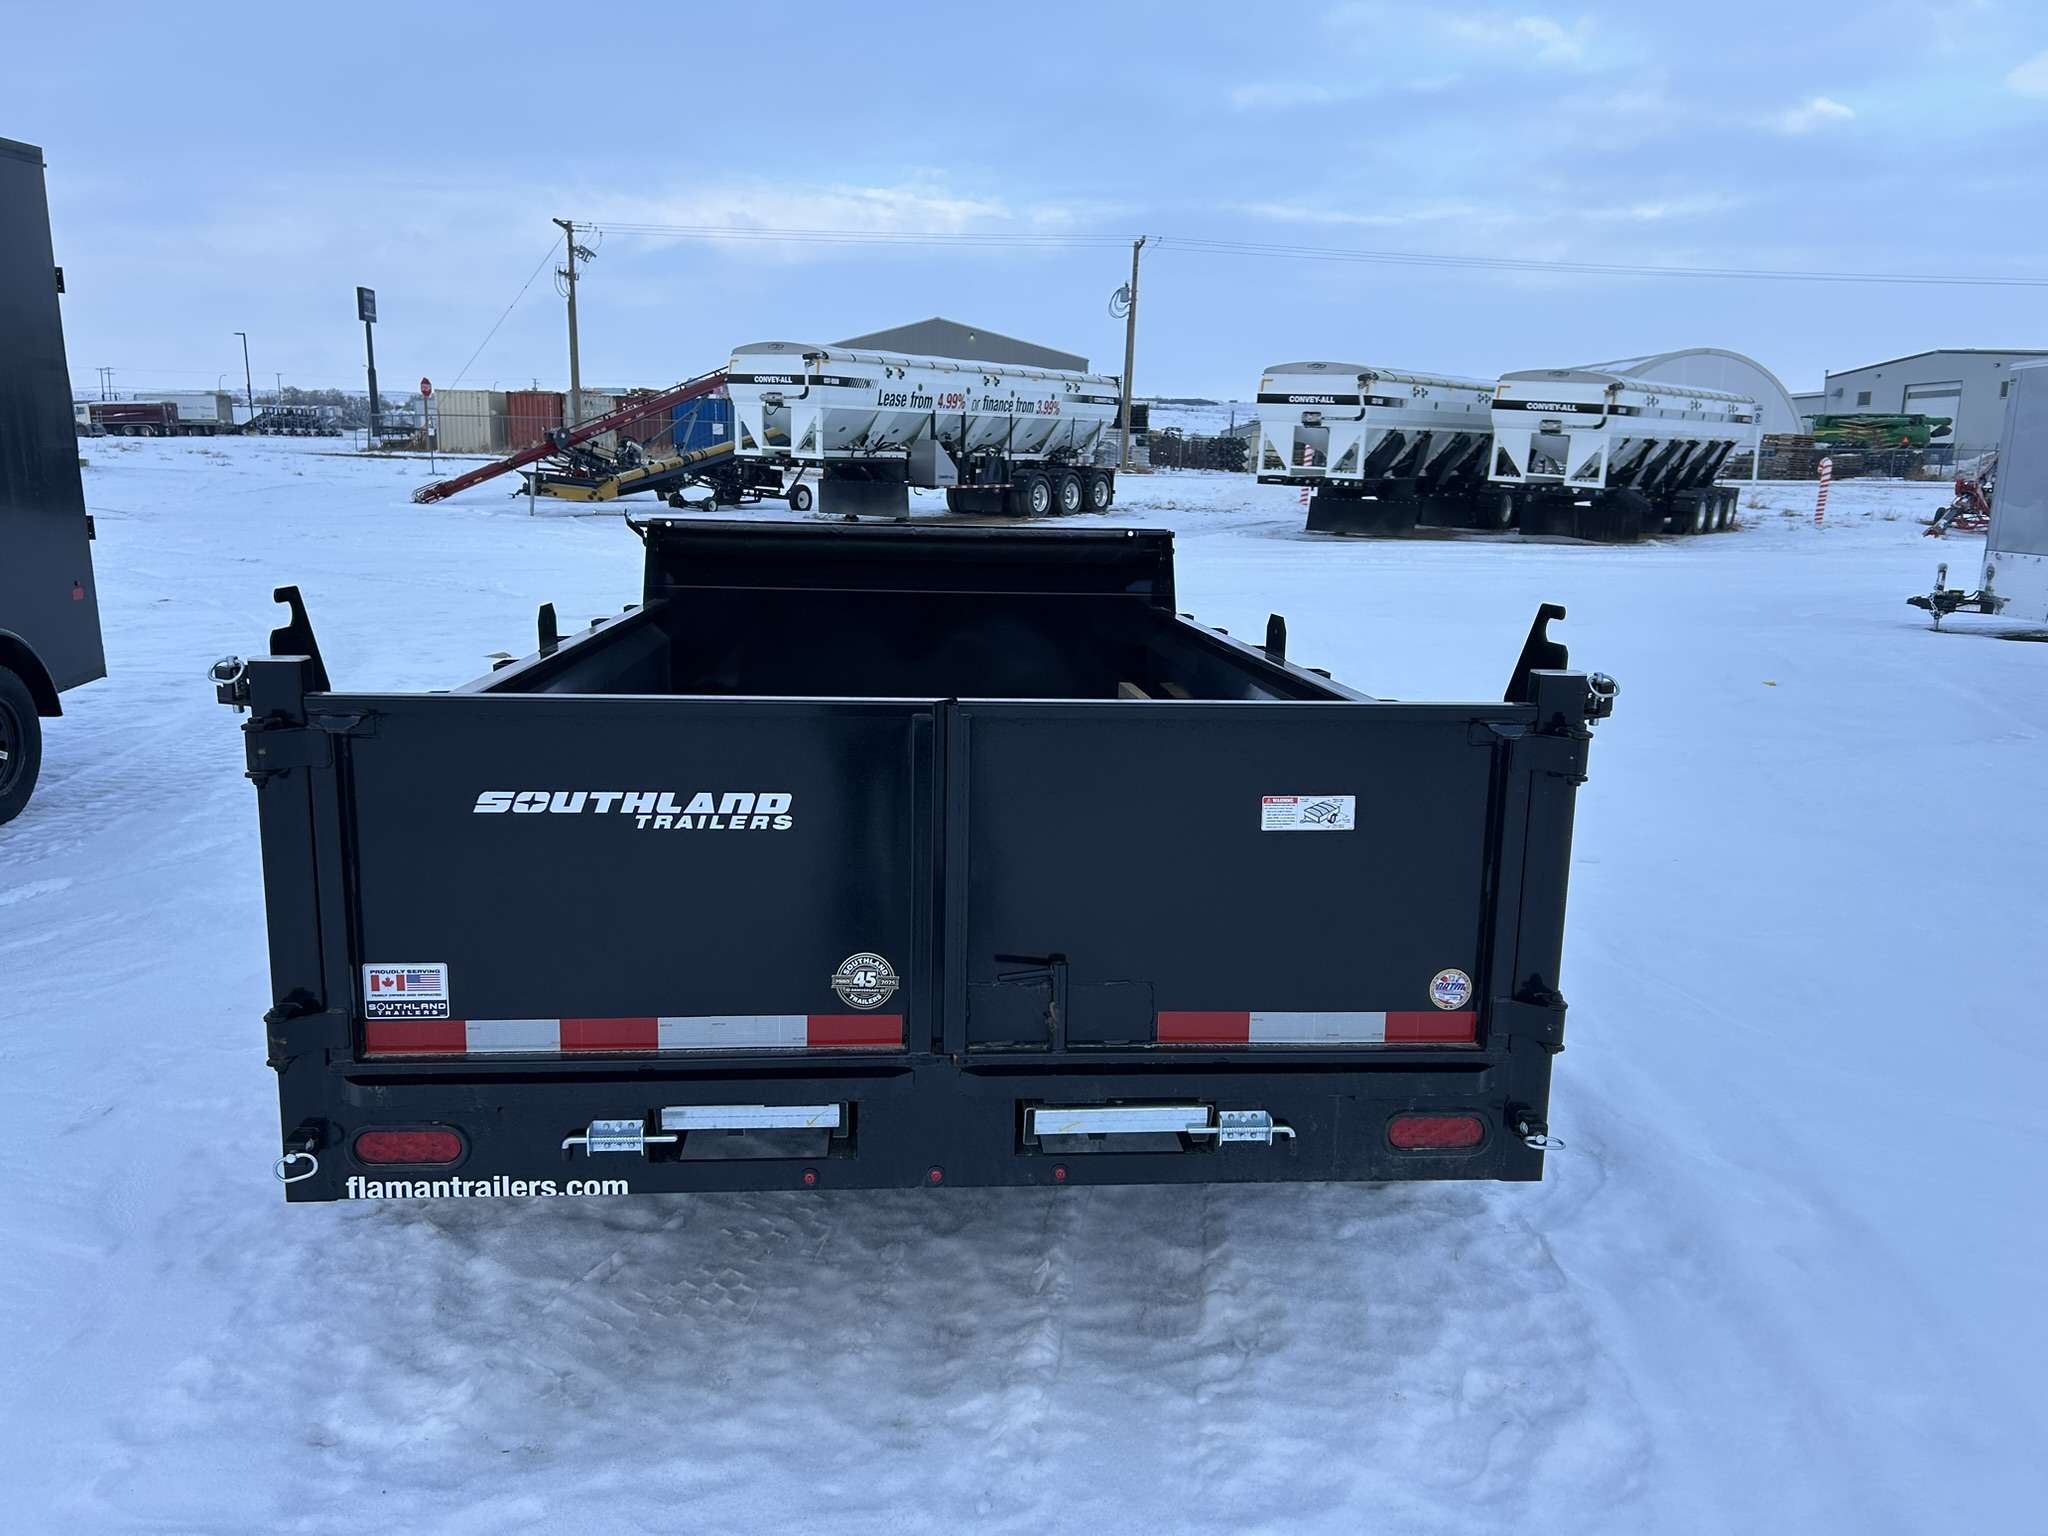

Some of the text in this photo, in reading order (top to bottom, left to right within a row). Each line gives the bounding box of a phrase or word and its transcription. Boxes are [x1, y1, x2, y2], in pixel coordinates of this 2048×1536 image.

[753, 375, 793, 384] CONVEY-ALL
[877, 388, 1062, 416] Lease from 4.99% or finance from 3.99%
[1288, 395, 1336, 404] CONVEY-ALL
[1526, 402, 1578, 412] CONVEY-ALL
[472, 791, 793, 814] SOUTHLAND
[635, 814, 793, 831] TRAILERS
[843, 957, 888, 976] SOUTHLAND
[852, 971, 877, 988] 45
[368, 1003, 446, 1011] SOUTHLAND
[849, 993, 882, 1005] TRAILERS
[345, 1175, 629, 1199] flamantrailers.com
